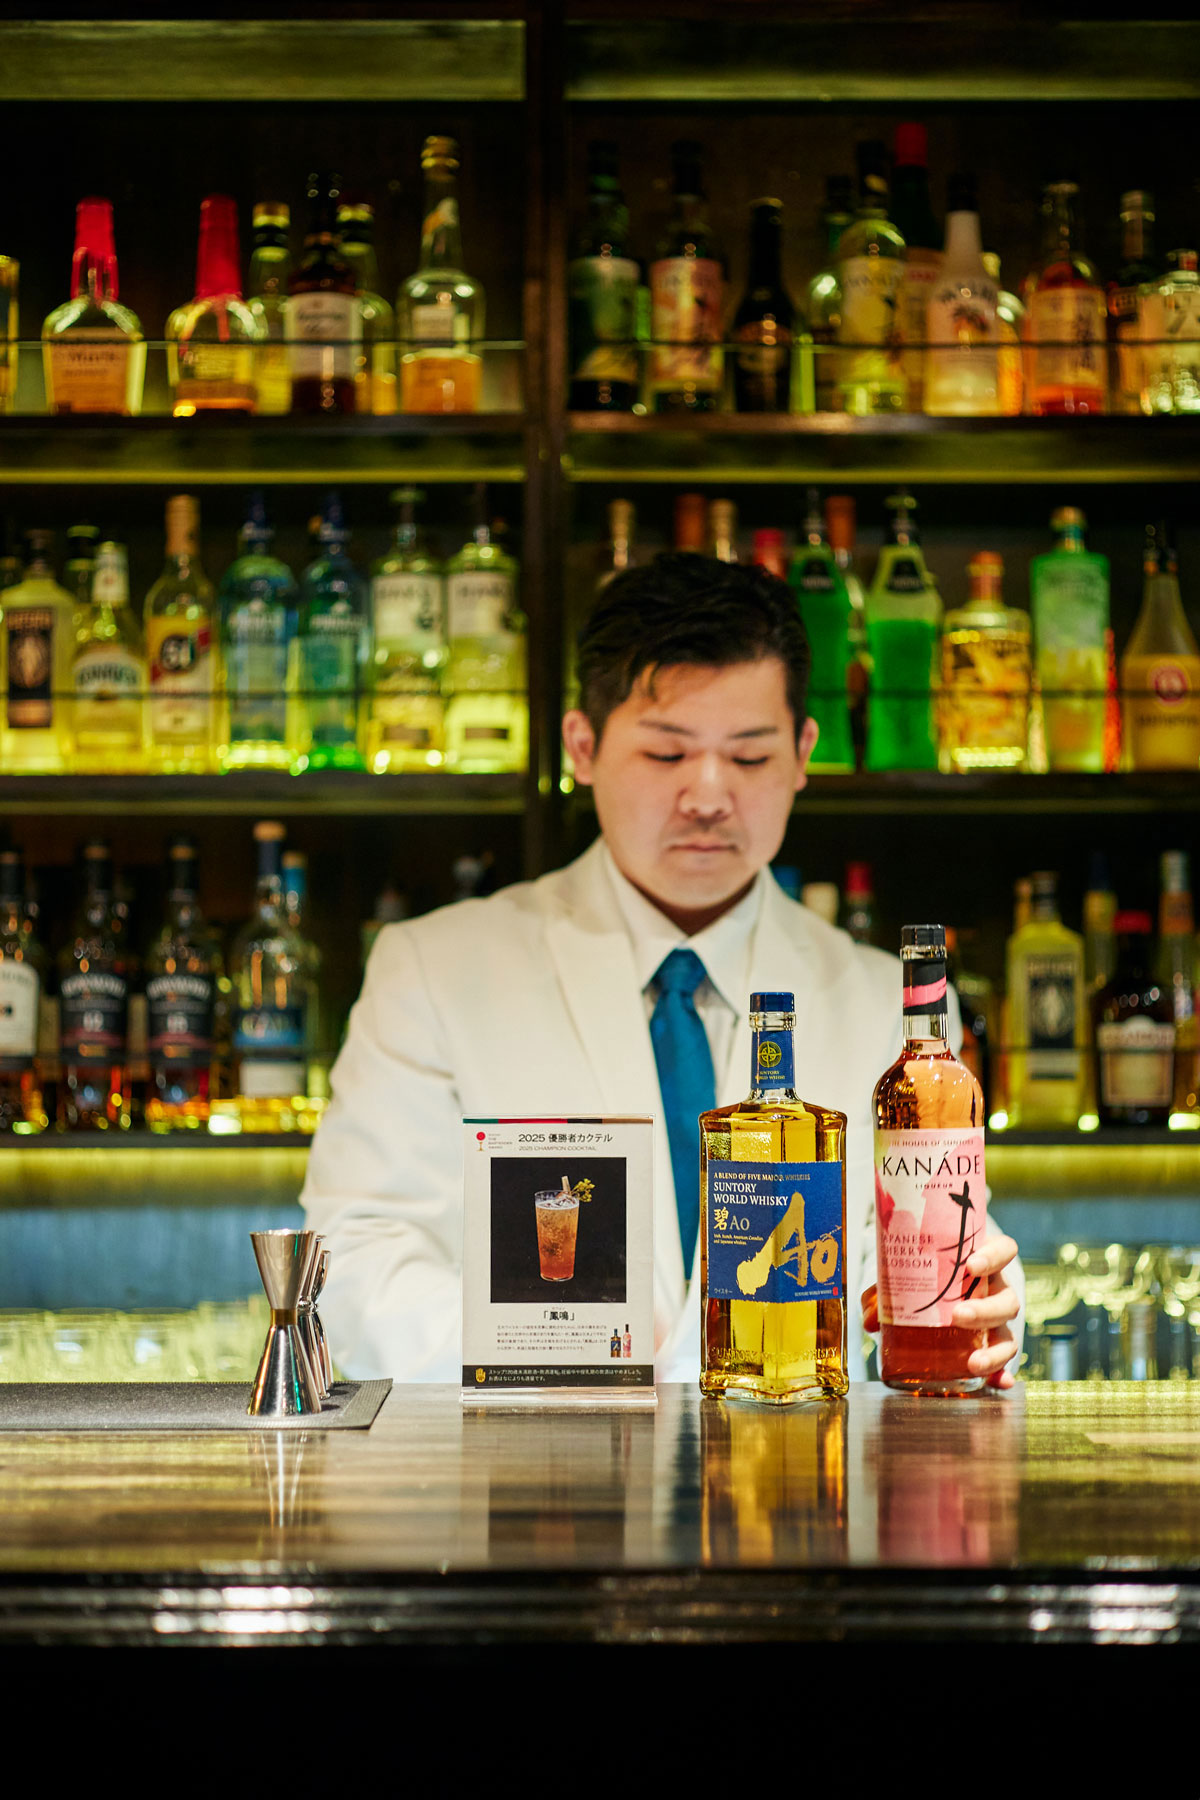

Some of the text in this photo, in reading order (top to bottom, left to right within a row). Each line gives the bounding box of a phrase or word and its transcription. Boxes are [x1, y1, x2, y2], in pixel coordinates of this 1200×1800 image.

[518, 1133, 614, 1143] 2025 優勝者カクテル
[882, 1150, 980, 1176] KANÁDE
[718, 1172, 738, 1180] BLEND
[738, 1172, 747, 1180] OF
[747, 1173, 761, 1181] FIVE
[761, 1173, 785, 1182] MAJOR
[713, 1182, 757, 1193] SUNTORY
[713, 1193, 789, 1207] WORLD WHISKY
[713, 1206, 750, 1231] 碧 AO
